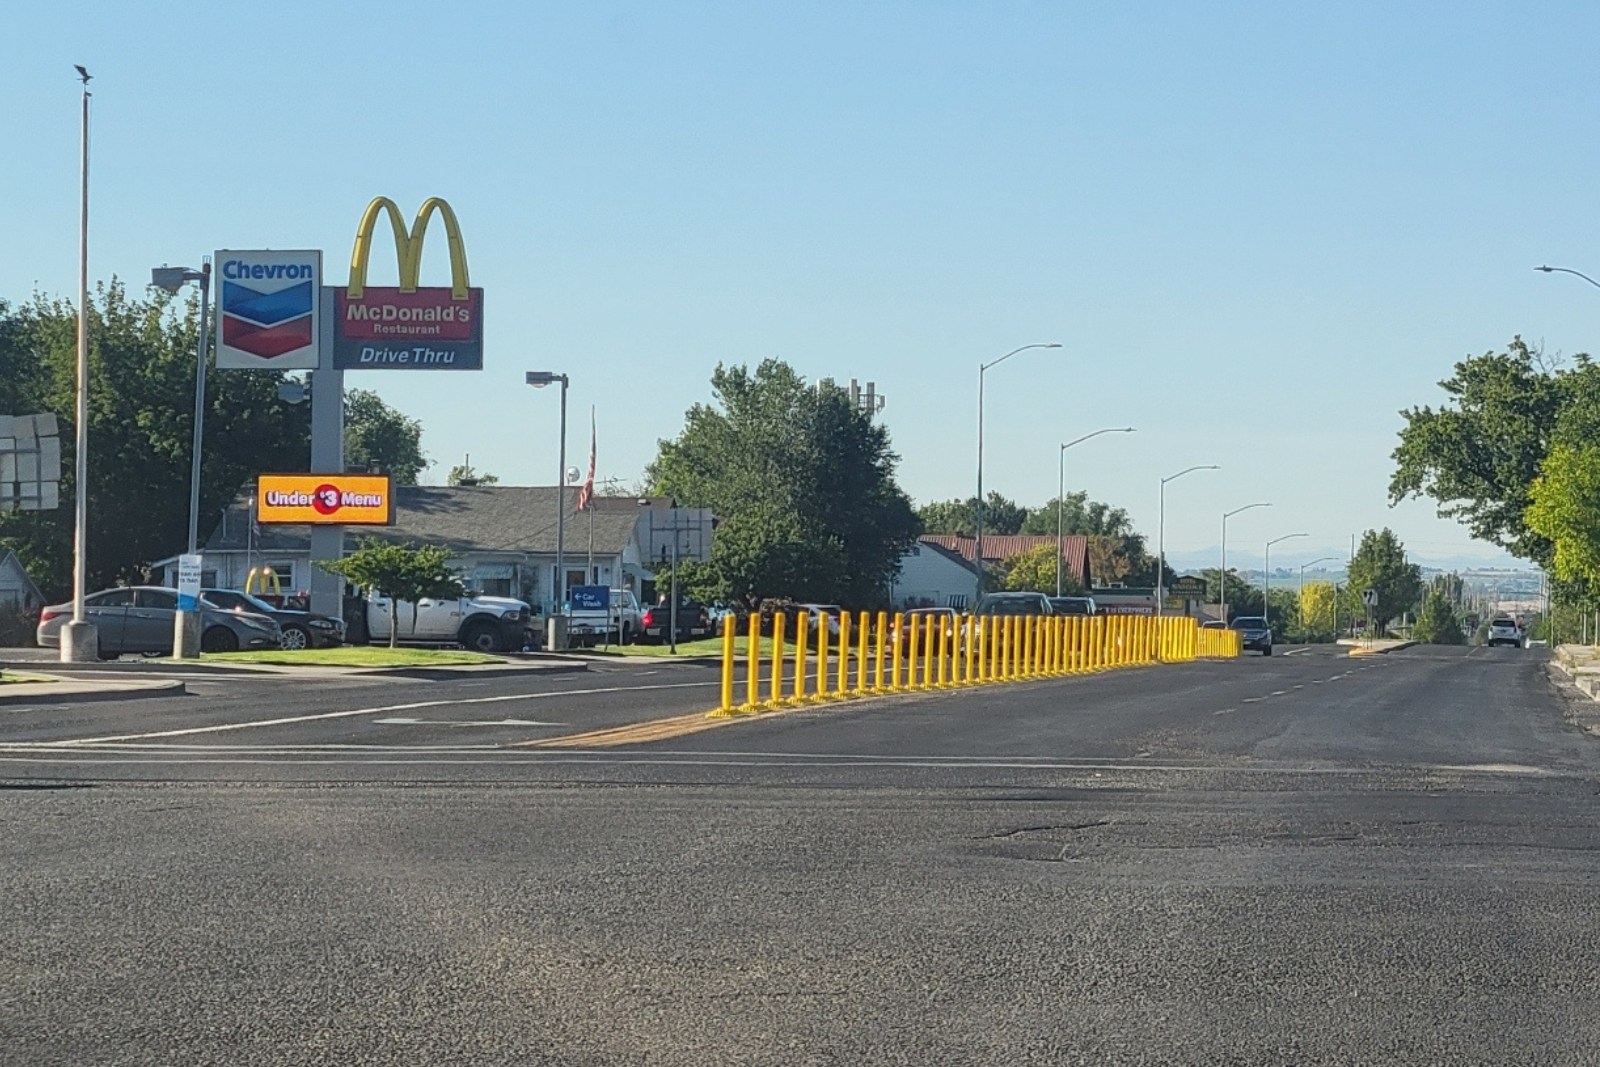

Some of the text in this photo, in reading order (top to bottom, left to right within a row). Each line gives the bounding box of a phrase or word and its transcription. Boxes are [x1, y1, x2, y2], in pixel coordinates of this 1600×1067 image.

[222, 259, 313, 280] Chevron
[347, 304, 470, 322] McDonald's
[373, 323, 441, 334] Restaurant
[360, 347, 455, 363] Drive Thru
[266, 490, 315, 506] Under
[341, 492, 382, 506] Menu
